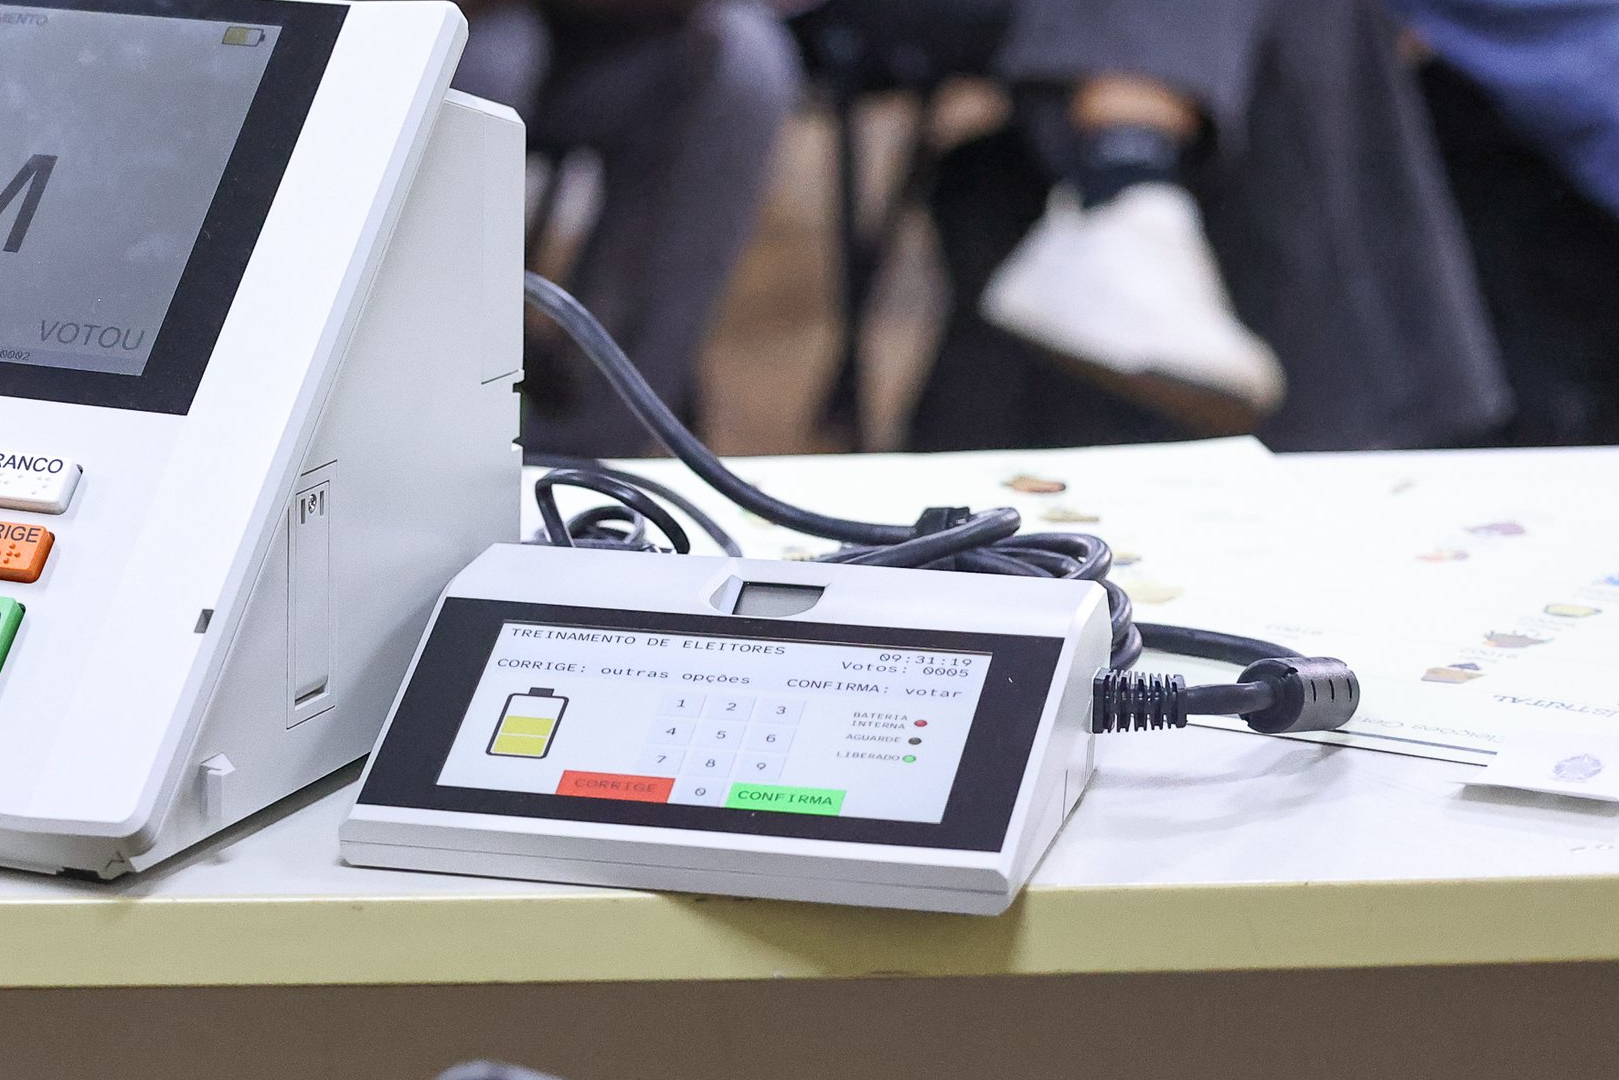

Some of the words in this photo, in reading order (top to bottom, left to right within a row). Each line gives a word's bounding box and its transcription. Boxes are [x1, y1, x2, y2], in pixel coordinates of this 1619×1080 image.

[39, 320, 145, 350] VOTOU
[0, 349, 31, 361] 0002
[511, 628, 636, 645] TREINAMENTO
[647, 638, 670, 648] DE
[682, 640, 786, 656] ELEITORES
[879, 653, 973, 667] 09:31:19
[842, 660, 908, 674] Votos:
[923, 667, 970, 678] 0005
[497, 658, 586, 673] CORRIGE:
[601, 666, 669, 680] outras
[682, 672, 751, 686] opções
[786, 678, 890, 694] CONFIRMA:
[905, 687, 963, 699] votar
[677, 699, 686, 708] 1
[726, 702, 737, 711] 2
[776, 705, 787, 715] 3
[853, 712, 908, 721] BATERIA
[852, 720, 906, 730] INTERNA
[665, 727, 677, 736] 4
[716, 730, 727, 739] 5
[766, 734, 776, 743] 6
[845, 733, 902, 743] AGUARDE
[657, 754, 667, 764] 7
[836, 751, 901, 761] LIBERADO
[706, 758, 716, 768] 8
[756, 762, 767, 771] 9
[574, 779, 657, 793] CORRIGE
[695, 787, 706, 797] 0
[737, 790, 833, 806] CONFIRMA
